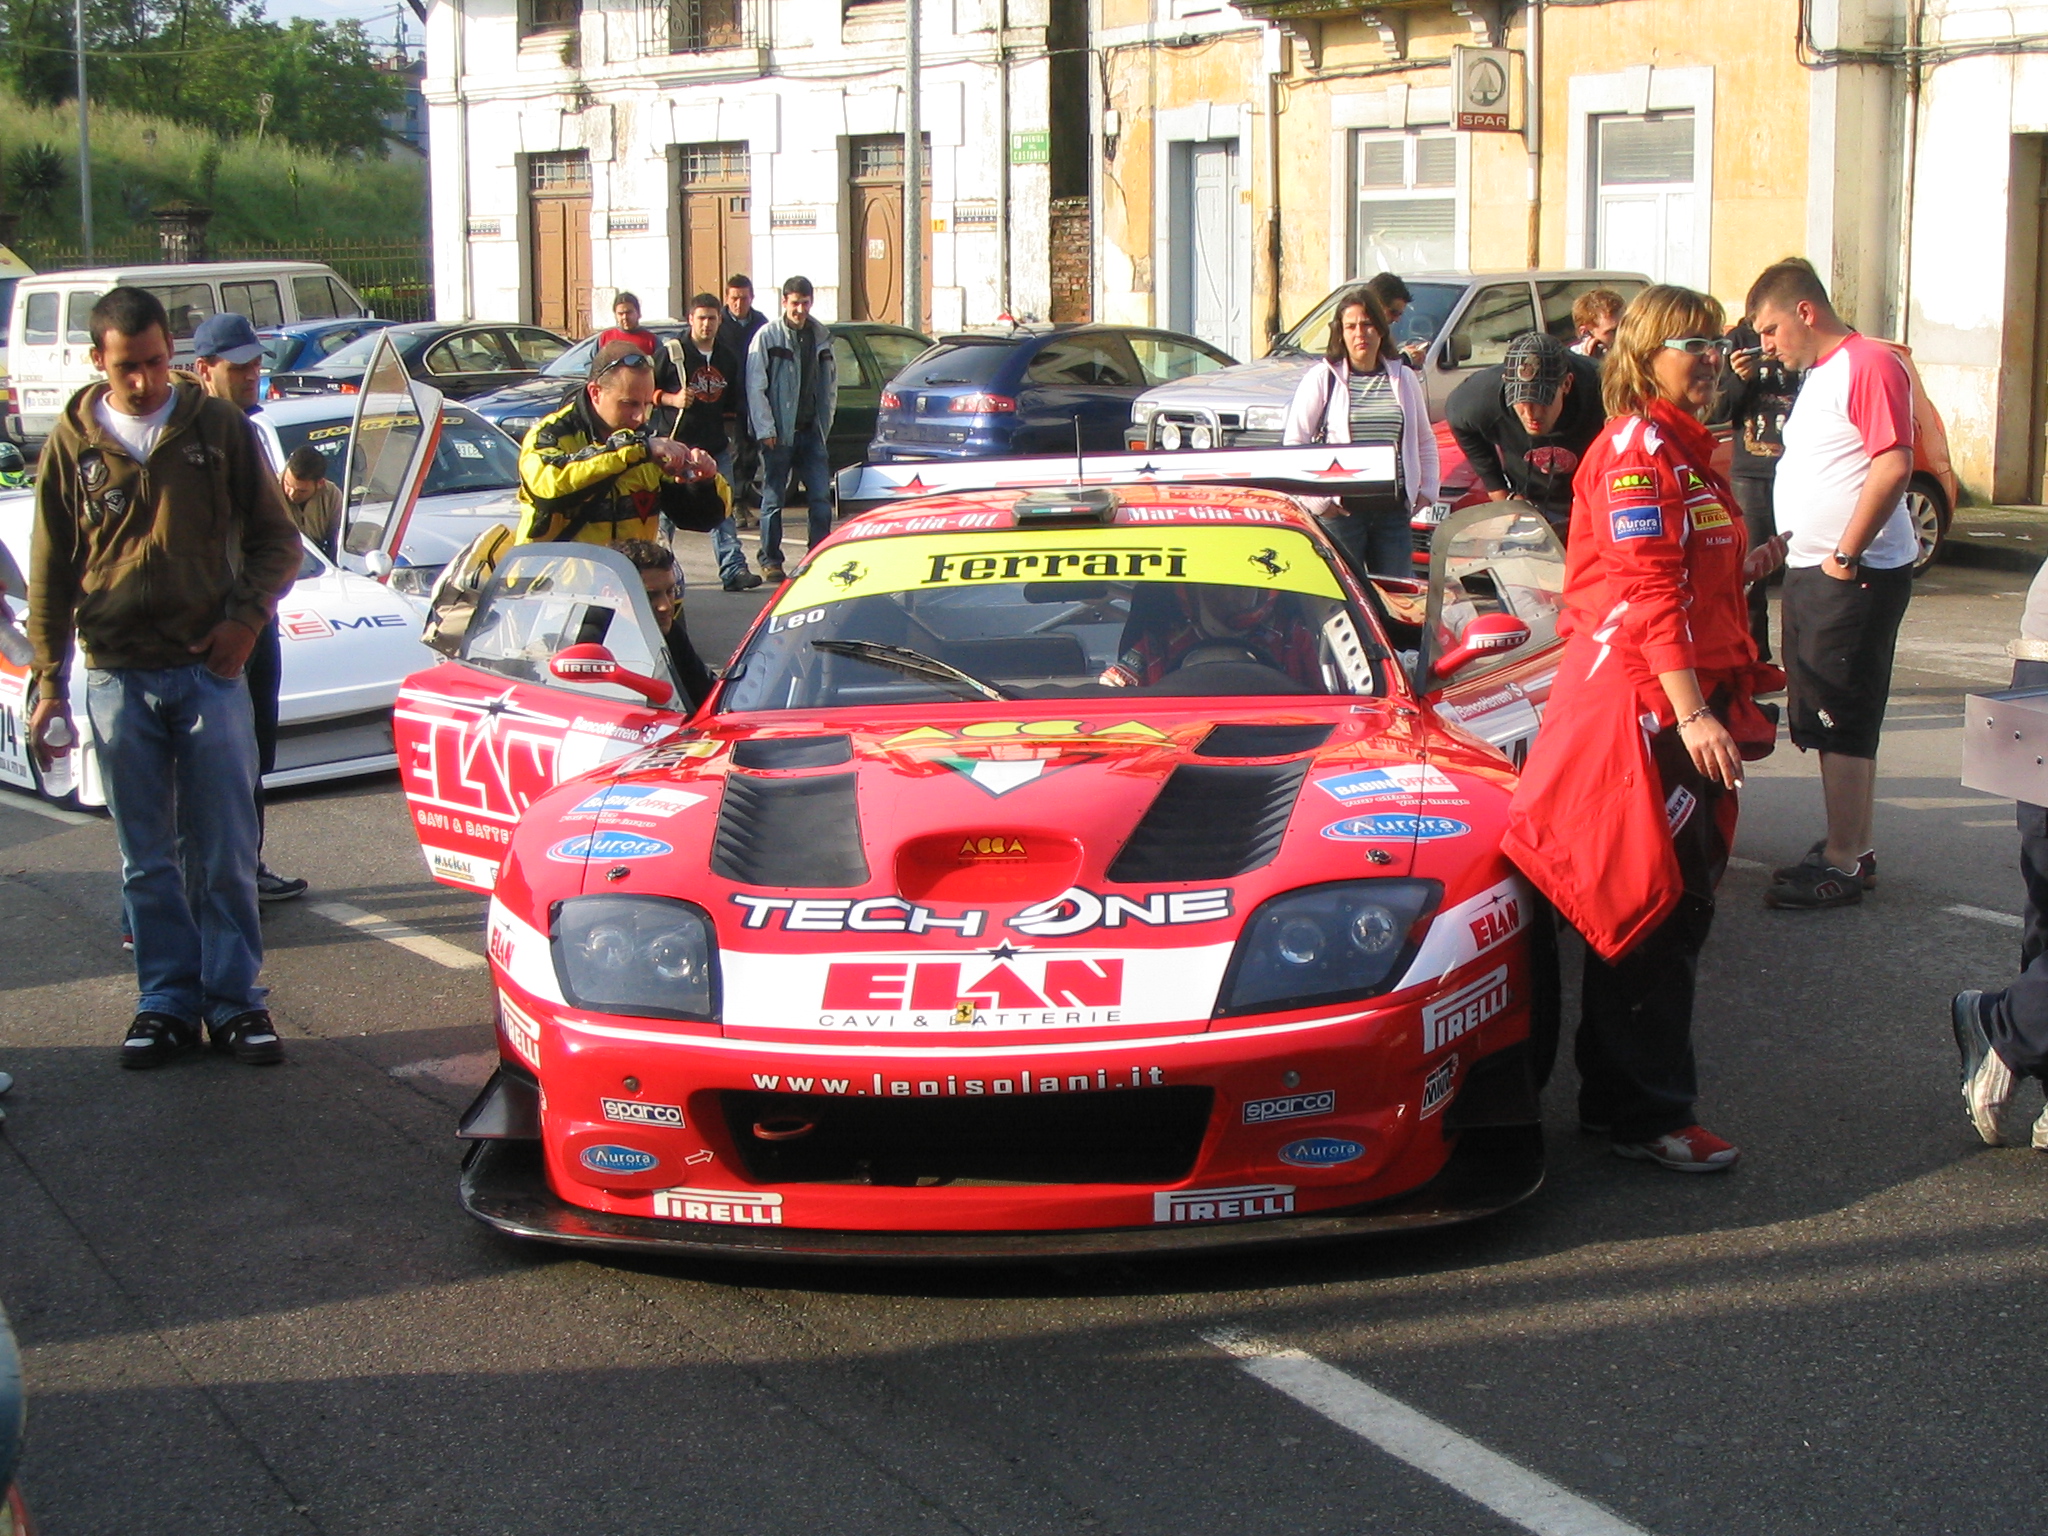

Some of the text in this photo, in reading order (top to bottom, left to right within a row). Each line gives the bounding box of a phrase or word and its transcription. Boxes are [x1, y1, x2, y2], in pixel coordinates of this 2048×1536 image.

[1462, 114, 1507, 126] SPAR
[933, 219, 945, 231] 17
[846, 512, 1001, 540] Mar-Gia-Ott
[1127, 506, 1286, 523] Mar-Gia-Ott
[1617, 518, 1658, 531] Aurora
[920, 547, 1188, 584] Ferrari
[767, 607, 826, 635] Leo
[1466, 630, 1529, 650] PIRELLI
[556, 658, 617, 673] PIRELLI
[881, 719, 1171, 746] ACCA
[393, 708, 564, 824] ELAN
[1396, 776, 1450, 787] OFFICE
[636, 798, 688, 813] OFFICE
[466, 820, 513, 845] BATTE
[1352, 818, 1455, 833] Aurora
[571, 838, 662, 851] Aurora
[959, 836, 1026, 855] ACCA
[733, 887, 1234, 938] TECH ONE
[1469, 898, 1520, 952] ELAN
[491, 925, 516, 972] ELAN
[820, 958, 1125, 1011] ELAN
[818, 1014, 895, 1028] CAVI
[913, 1014, 930, 1028] &
[1421, 963, 1509, 1055] PIRELLI
[498, 986, 542, 1070] PIRELLI
[752, 1065, 1165, 1097] www.leoisolani.it
[605, 1100, 681, 1121] sparco
[1246, 1093, 1332, 1121] sparco
[595, 1149, 651, 1164] Aurora
[1295, 1143, 1356, 1157] Aurora
[653, 1186, 784, 1224] PIRELLI
[1153, 1183, 1297, 1223] PIRELLI
